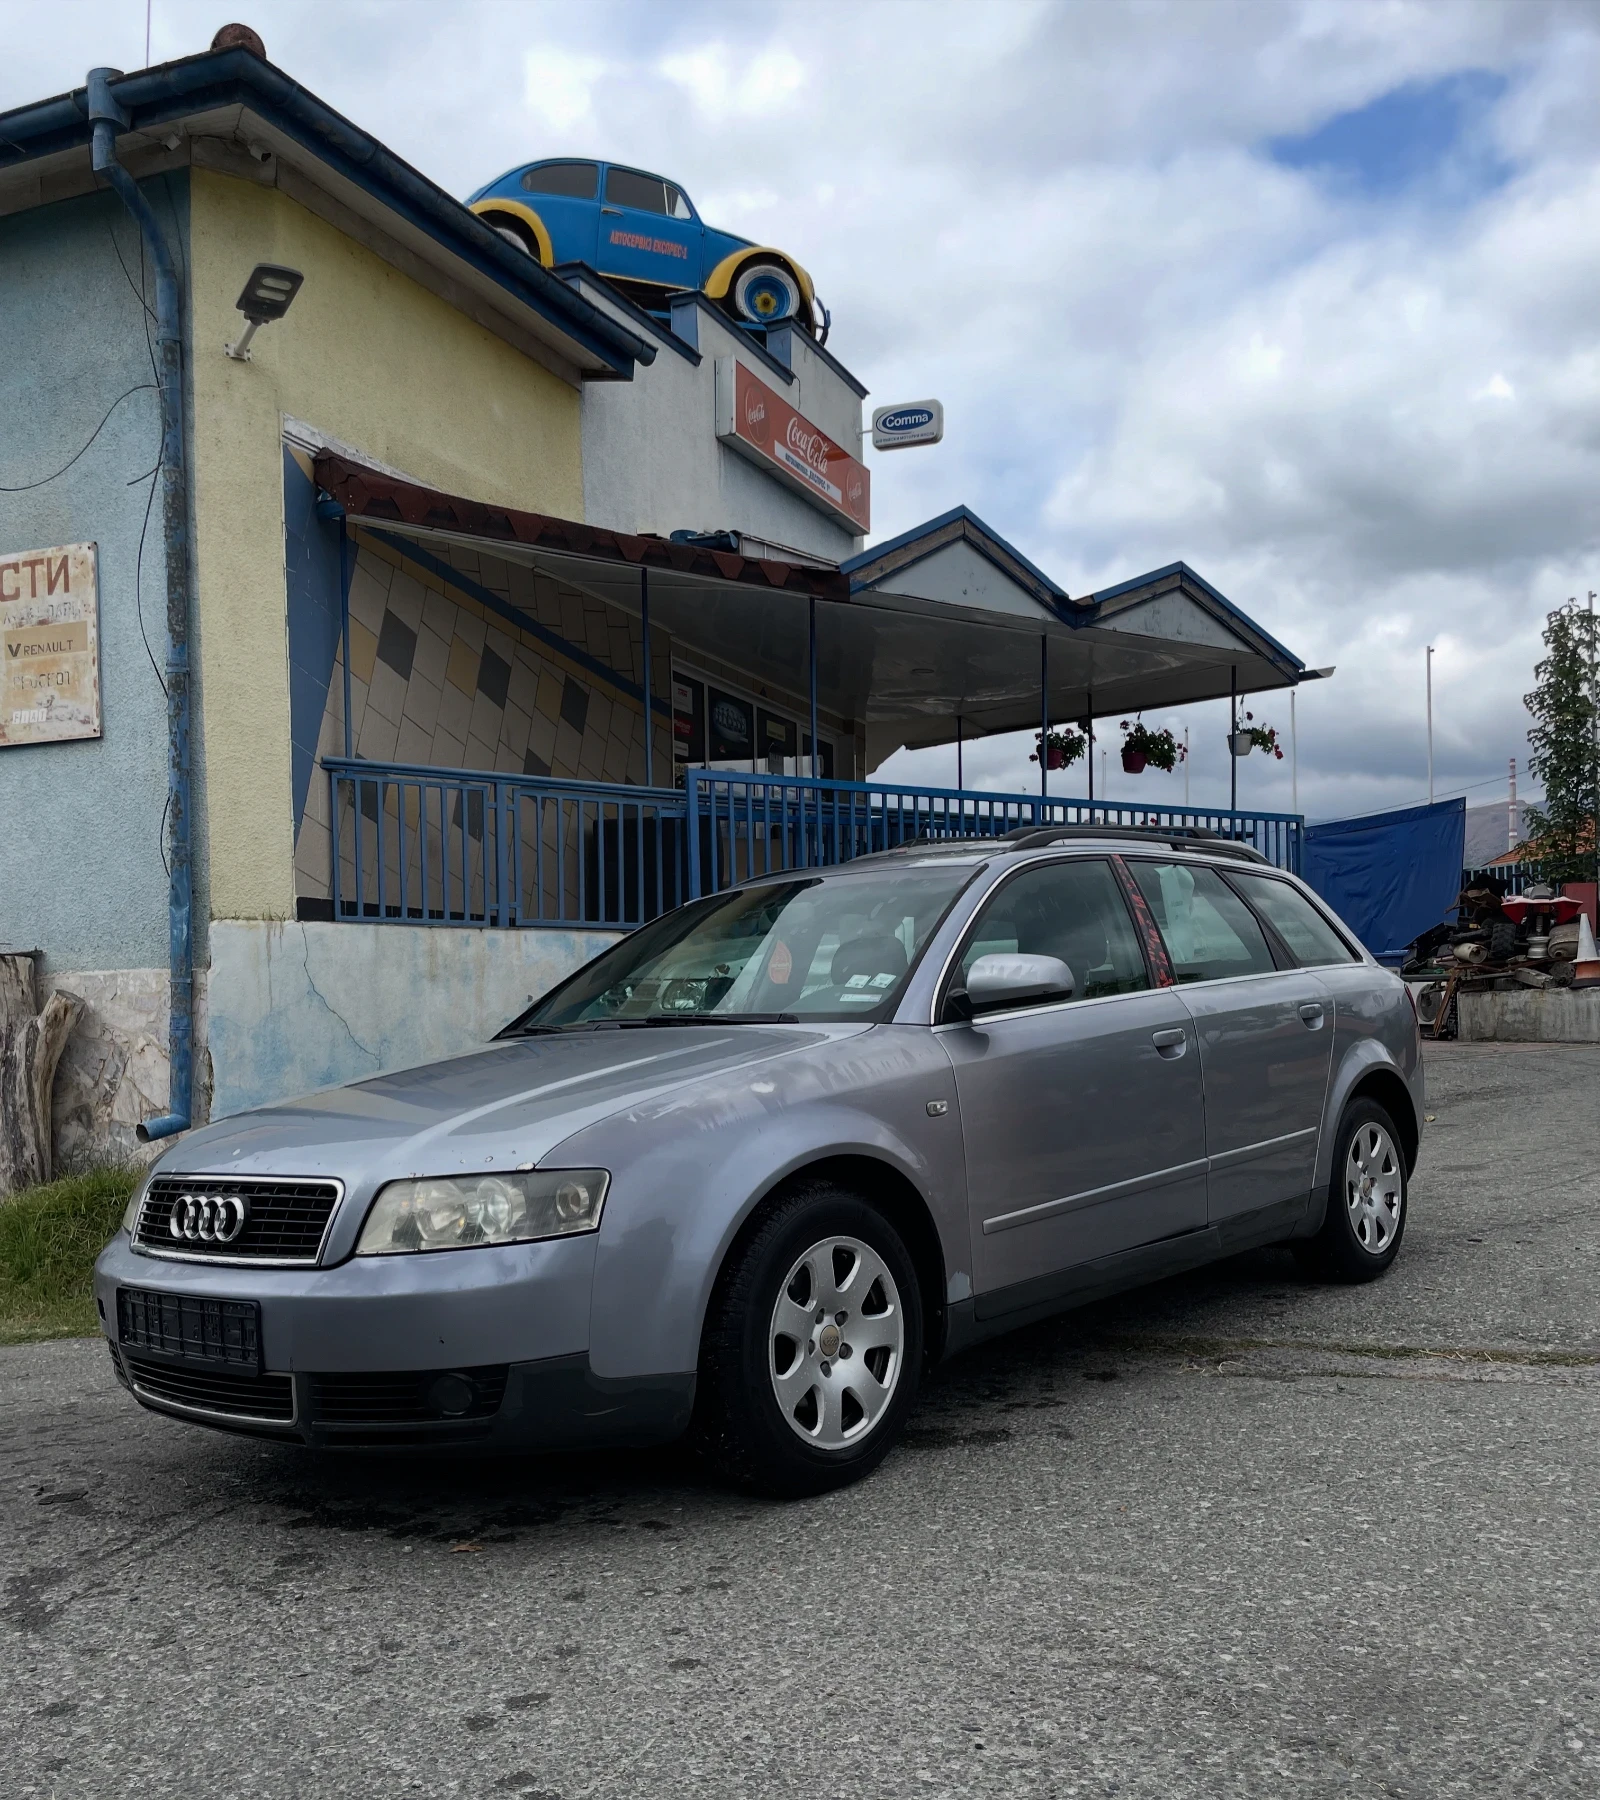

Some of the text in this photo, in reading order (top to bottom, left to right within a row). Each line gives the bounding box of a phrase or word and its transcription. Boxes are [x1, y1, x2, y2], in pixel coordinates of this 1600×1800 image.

[886, 414, 929, 428] Comma
[786, 417, 829, 475] Coca-Cola
[23, 639, 74, 656] RENAULT
